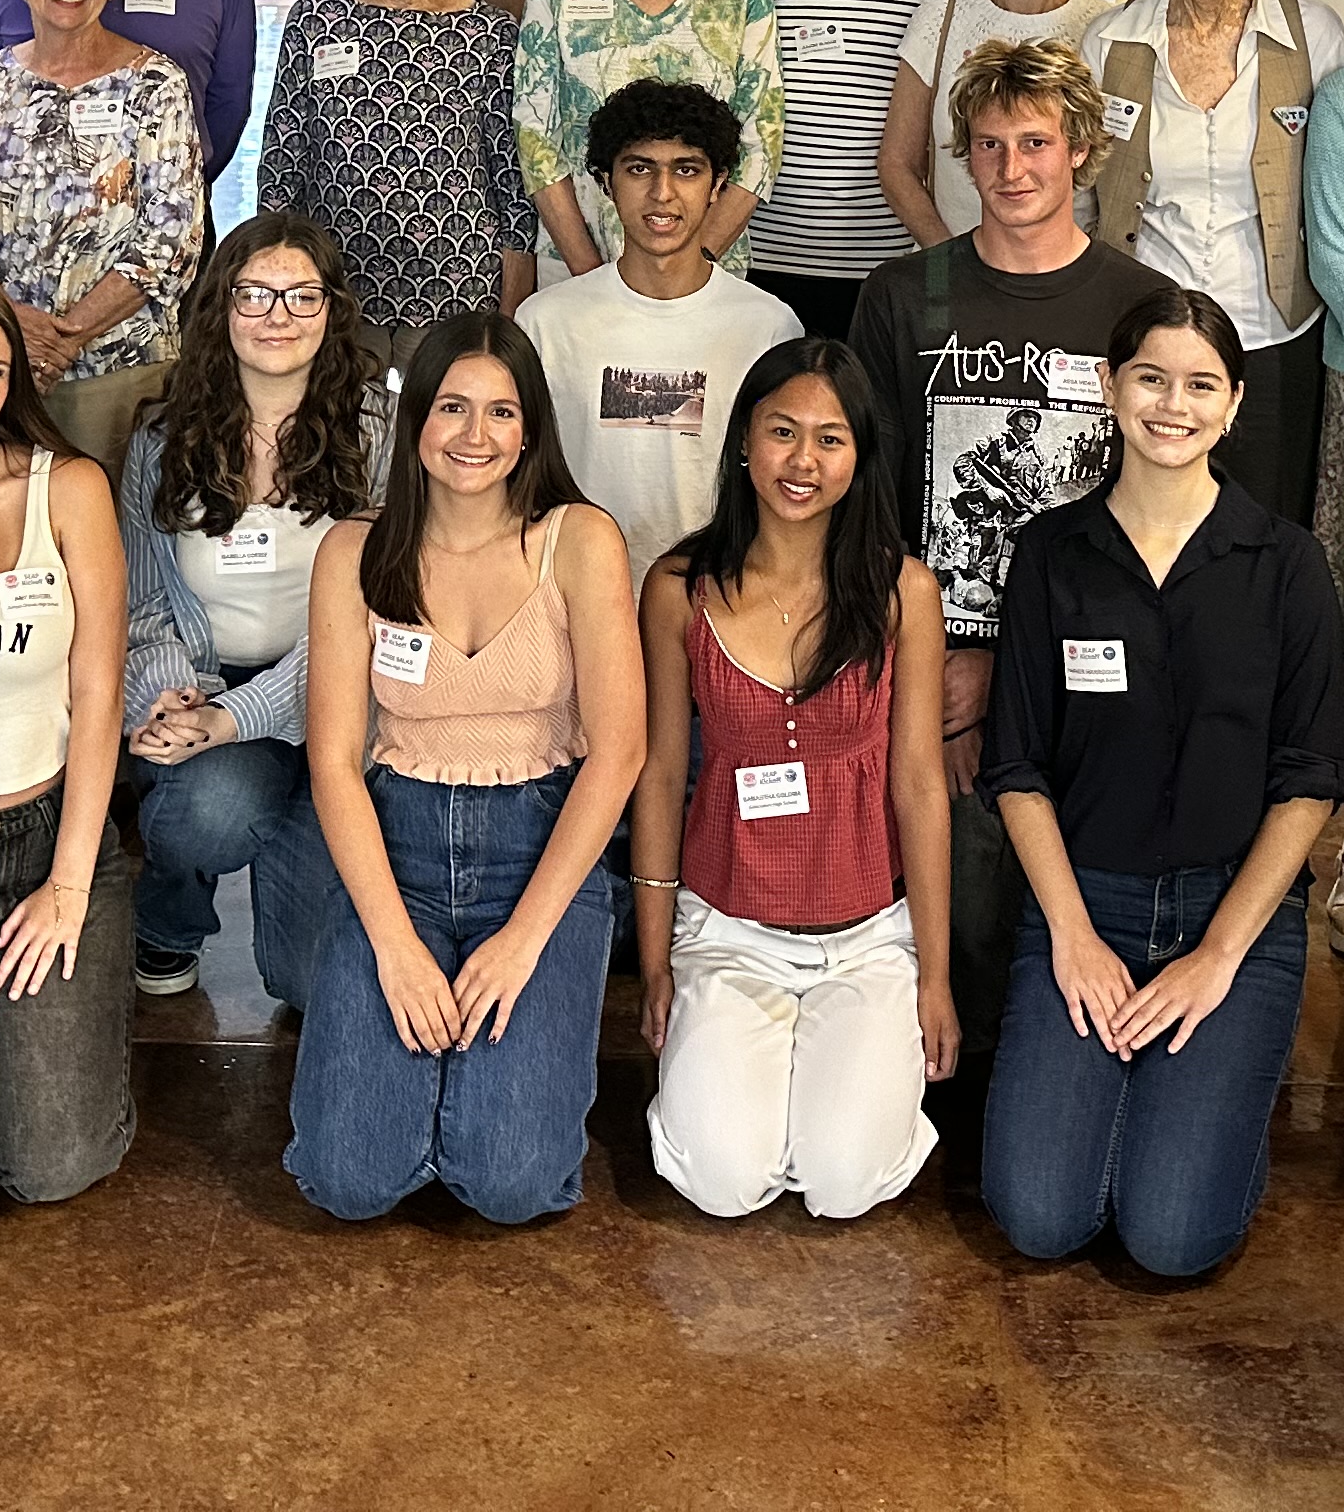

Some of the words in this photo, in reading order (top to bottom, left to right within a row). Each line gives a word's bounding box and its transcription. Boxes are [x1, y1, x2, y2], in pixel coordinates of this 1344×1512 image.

[1278, 110, 1305, 120] VOTE
[934, 395, 986, 404] COUNTRY'S
[989, 397, 1041, 408] PROBLEMS
[1048, 401, 1067, 411] THE
